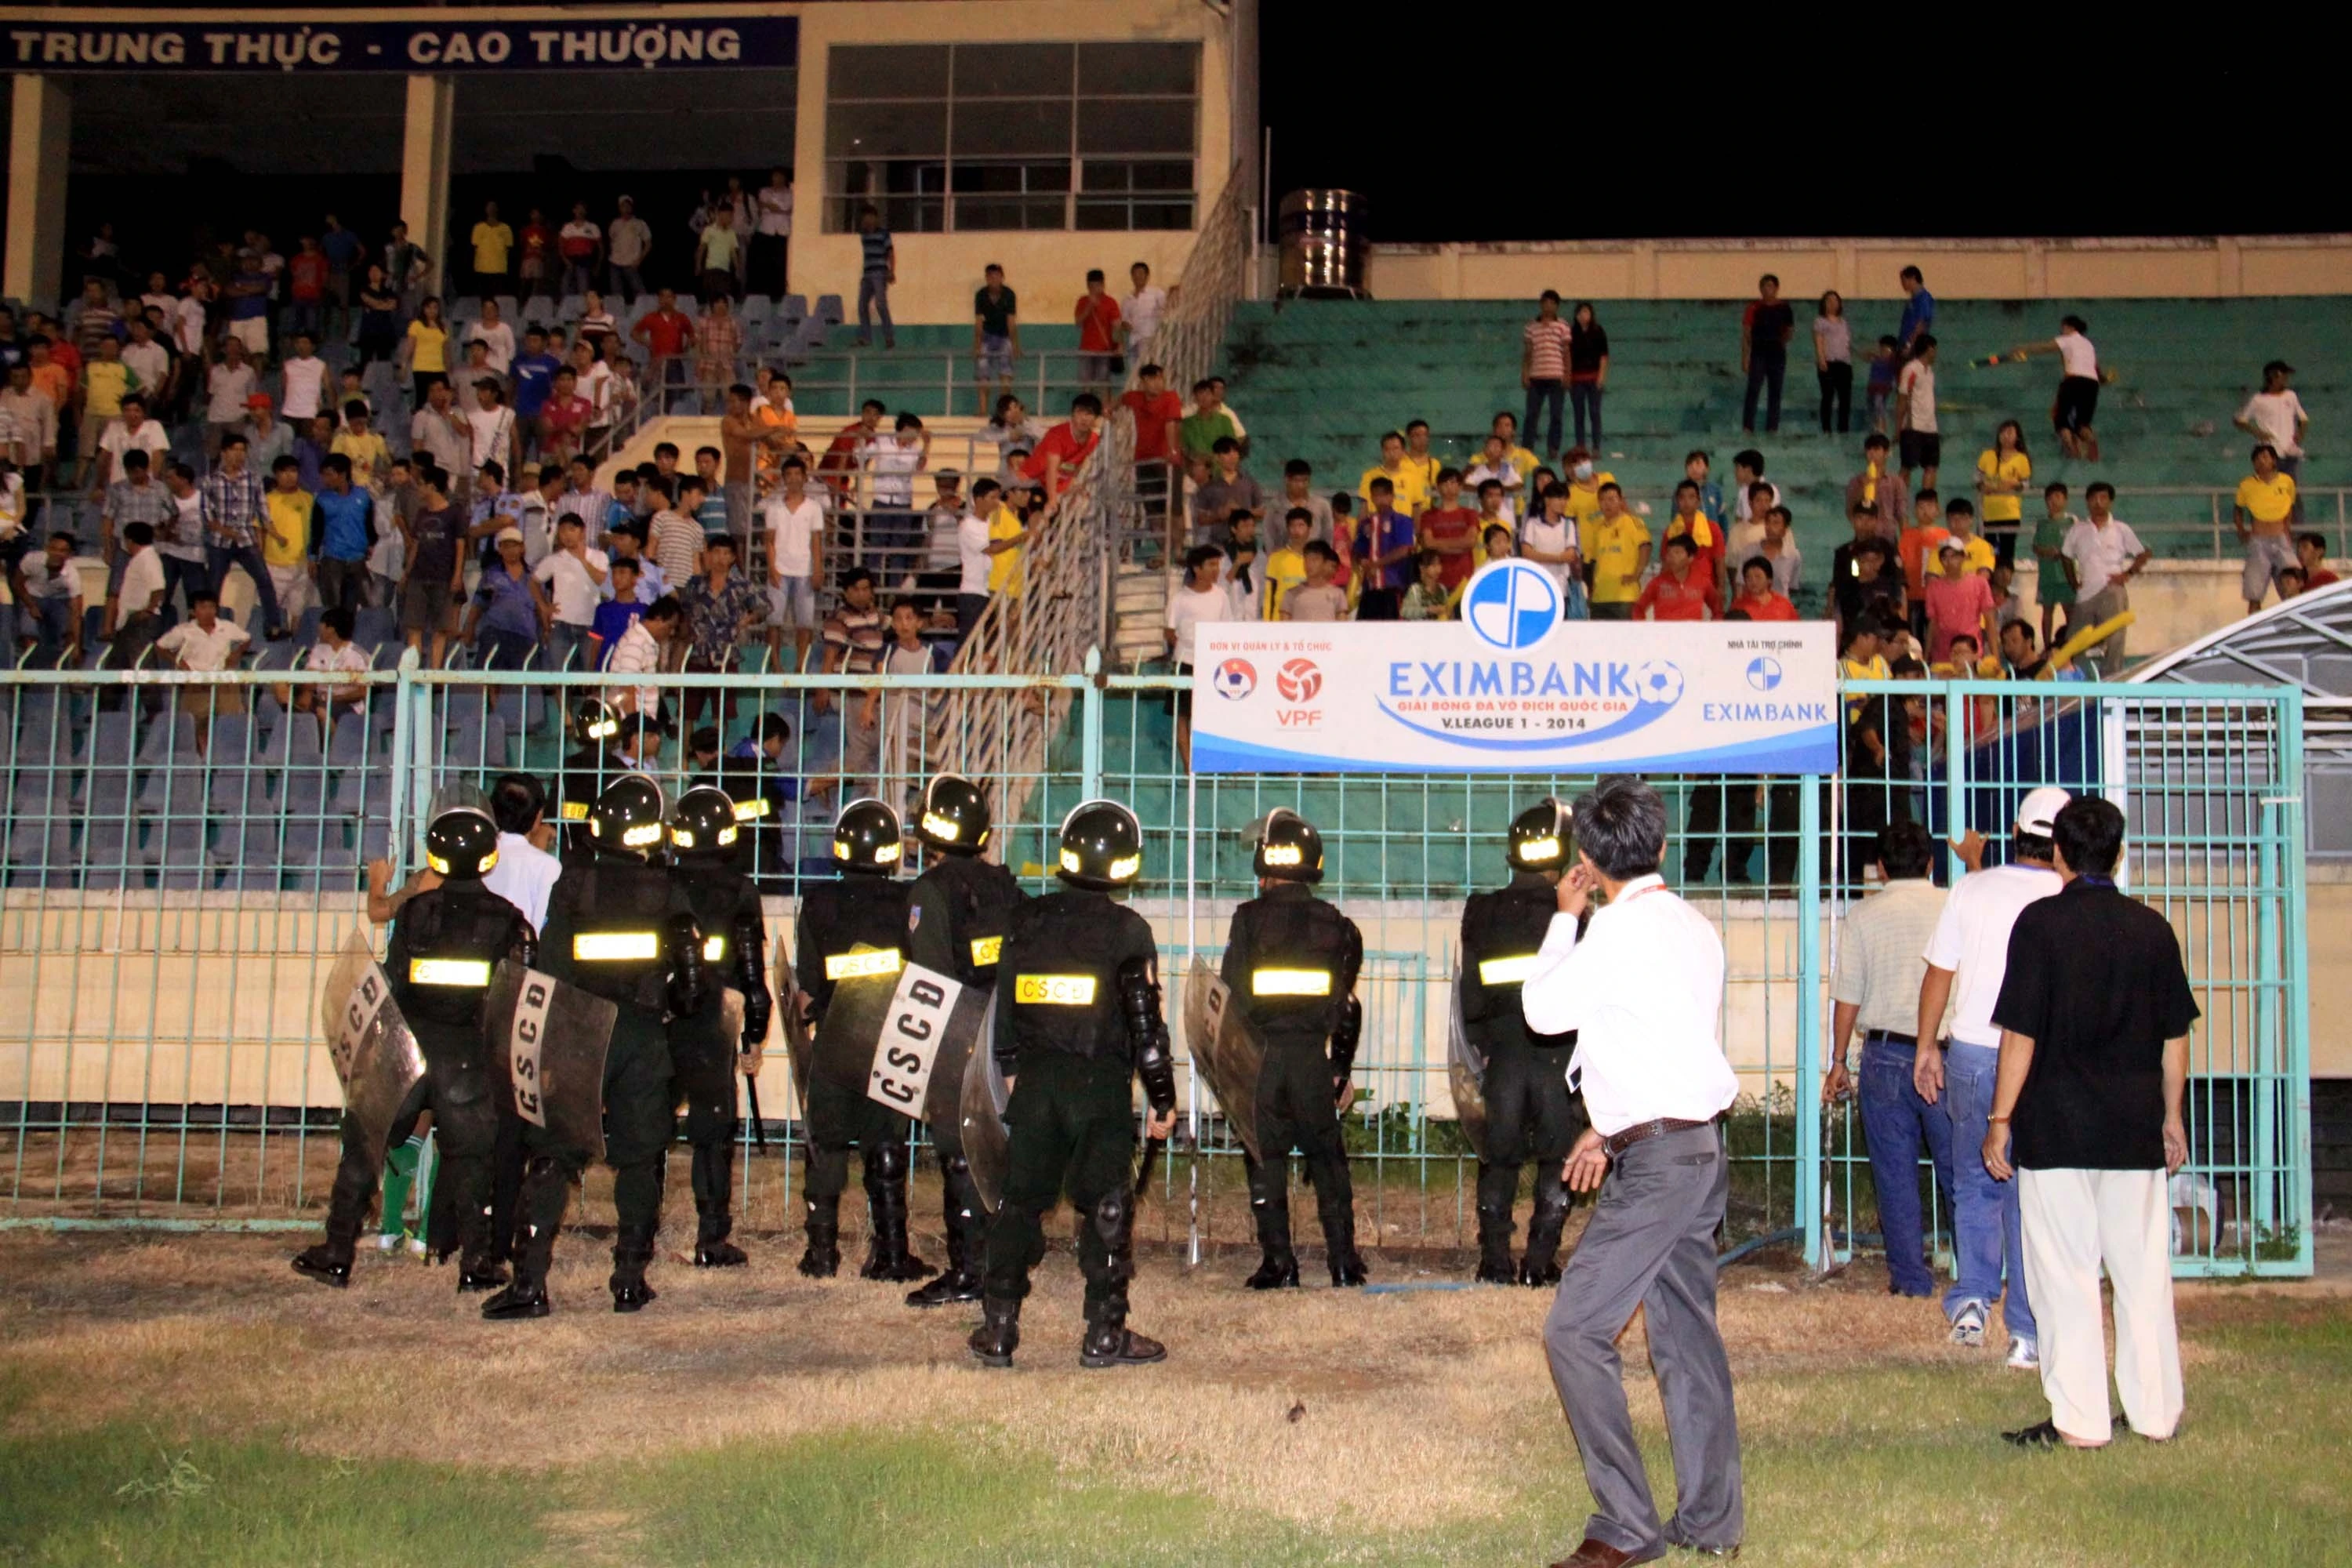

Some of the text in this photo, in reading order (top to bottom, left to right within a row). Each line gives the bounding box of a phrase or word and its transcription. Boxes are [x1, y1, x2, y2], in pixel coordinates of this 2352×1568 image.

[10, 29, 186, 64] TRUNG
[203, 26, 341, 71] THỰC
[407, 31, 512, 64] CAO
[529, 24, 741, 69] THƯỢNG
[1389, 662, 1635, 696] EXIMBANK
[1602, 701, 1628, 712] GIA
[1703, 703, 1828, 721] EXIMBANK
[1276, 710, 1323, 726] VPF
[1441, 717, 1515, 729] V.LEAGUE
[1520, 717, 1527, 729] 1
[1547, 717, 1586, 729] 2014
